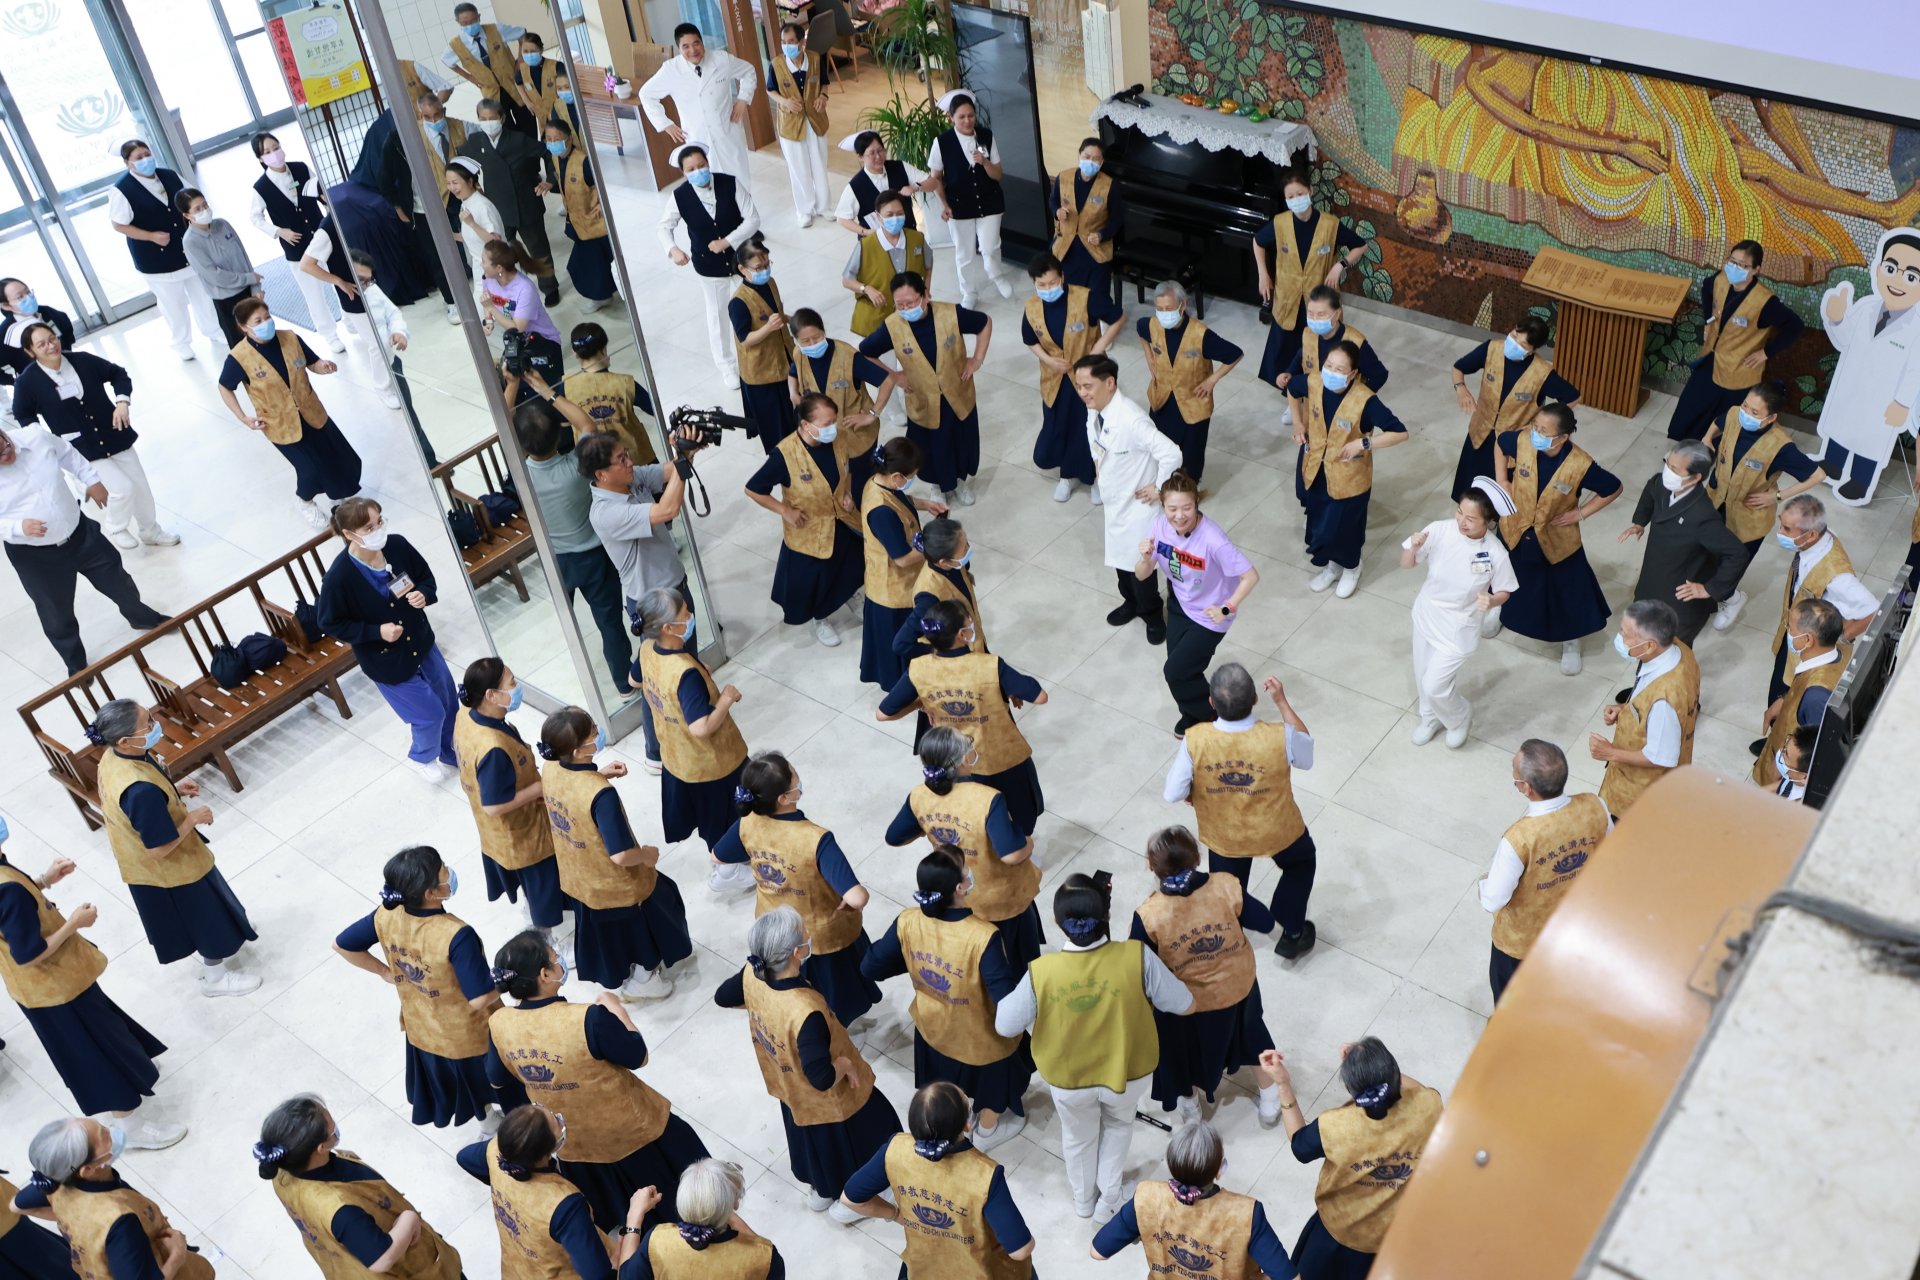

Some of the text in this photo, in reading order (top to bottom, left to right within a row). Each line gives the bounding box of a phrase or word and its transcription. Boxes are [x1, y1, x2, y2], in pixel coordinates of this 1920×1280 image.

[1204, 760, 1266, 774] 佛教慈濟志工
[1536, 836, 1597, 866] 佛教慈濟志工
[897, 1185, 969, 1218] 佛教慈濟志工
[920, 1225, 941, 1237] TZU-CHI
[941, 1229, 975, 1245] VOLUNTEERS
[1153, 1231, 1228, 1260] 佛教慈濟志工
[1151, 1263, 1177, 1275] BUDDHIST
[1177, 1265, 1198, 1279] TZU-CHI
